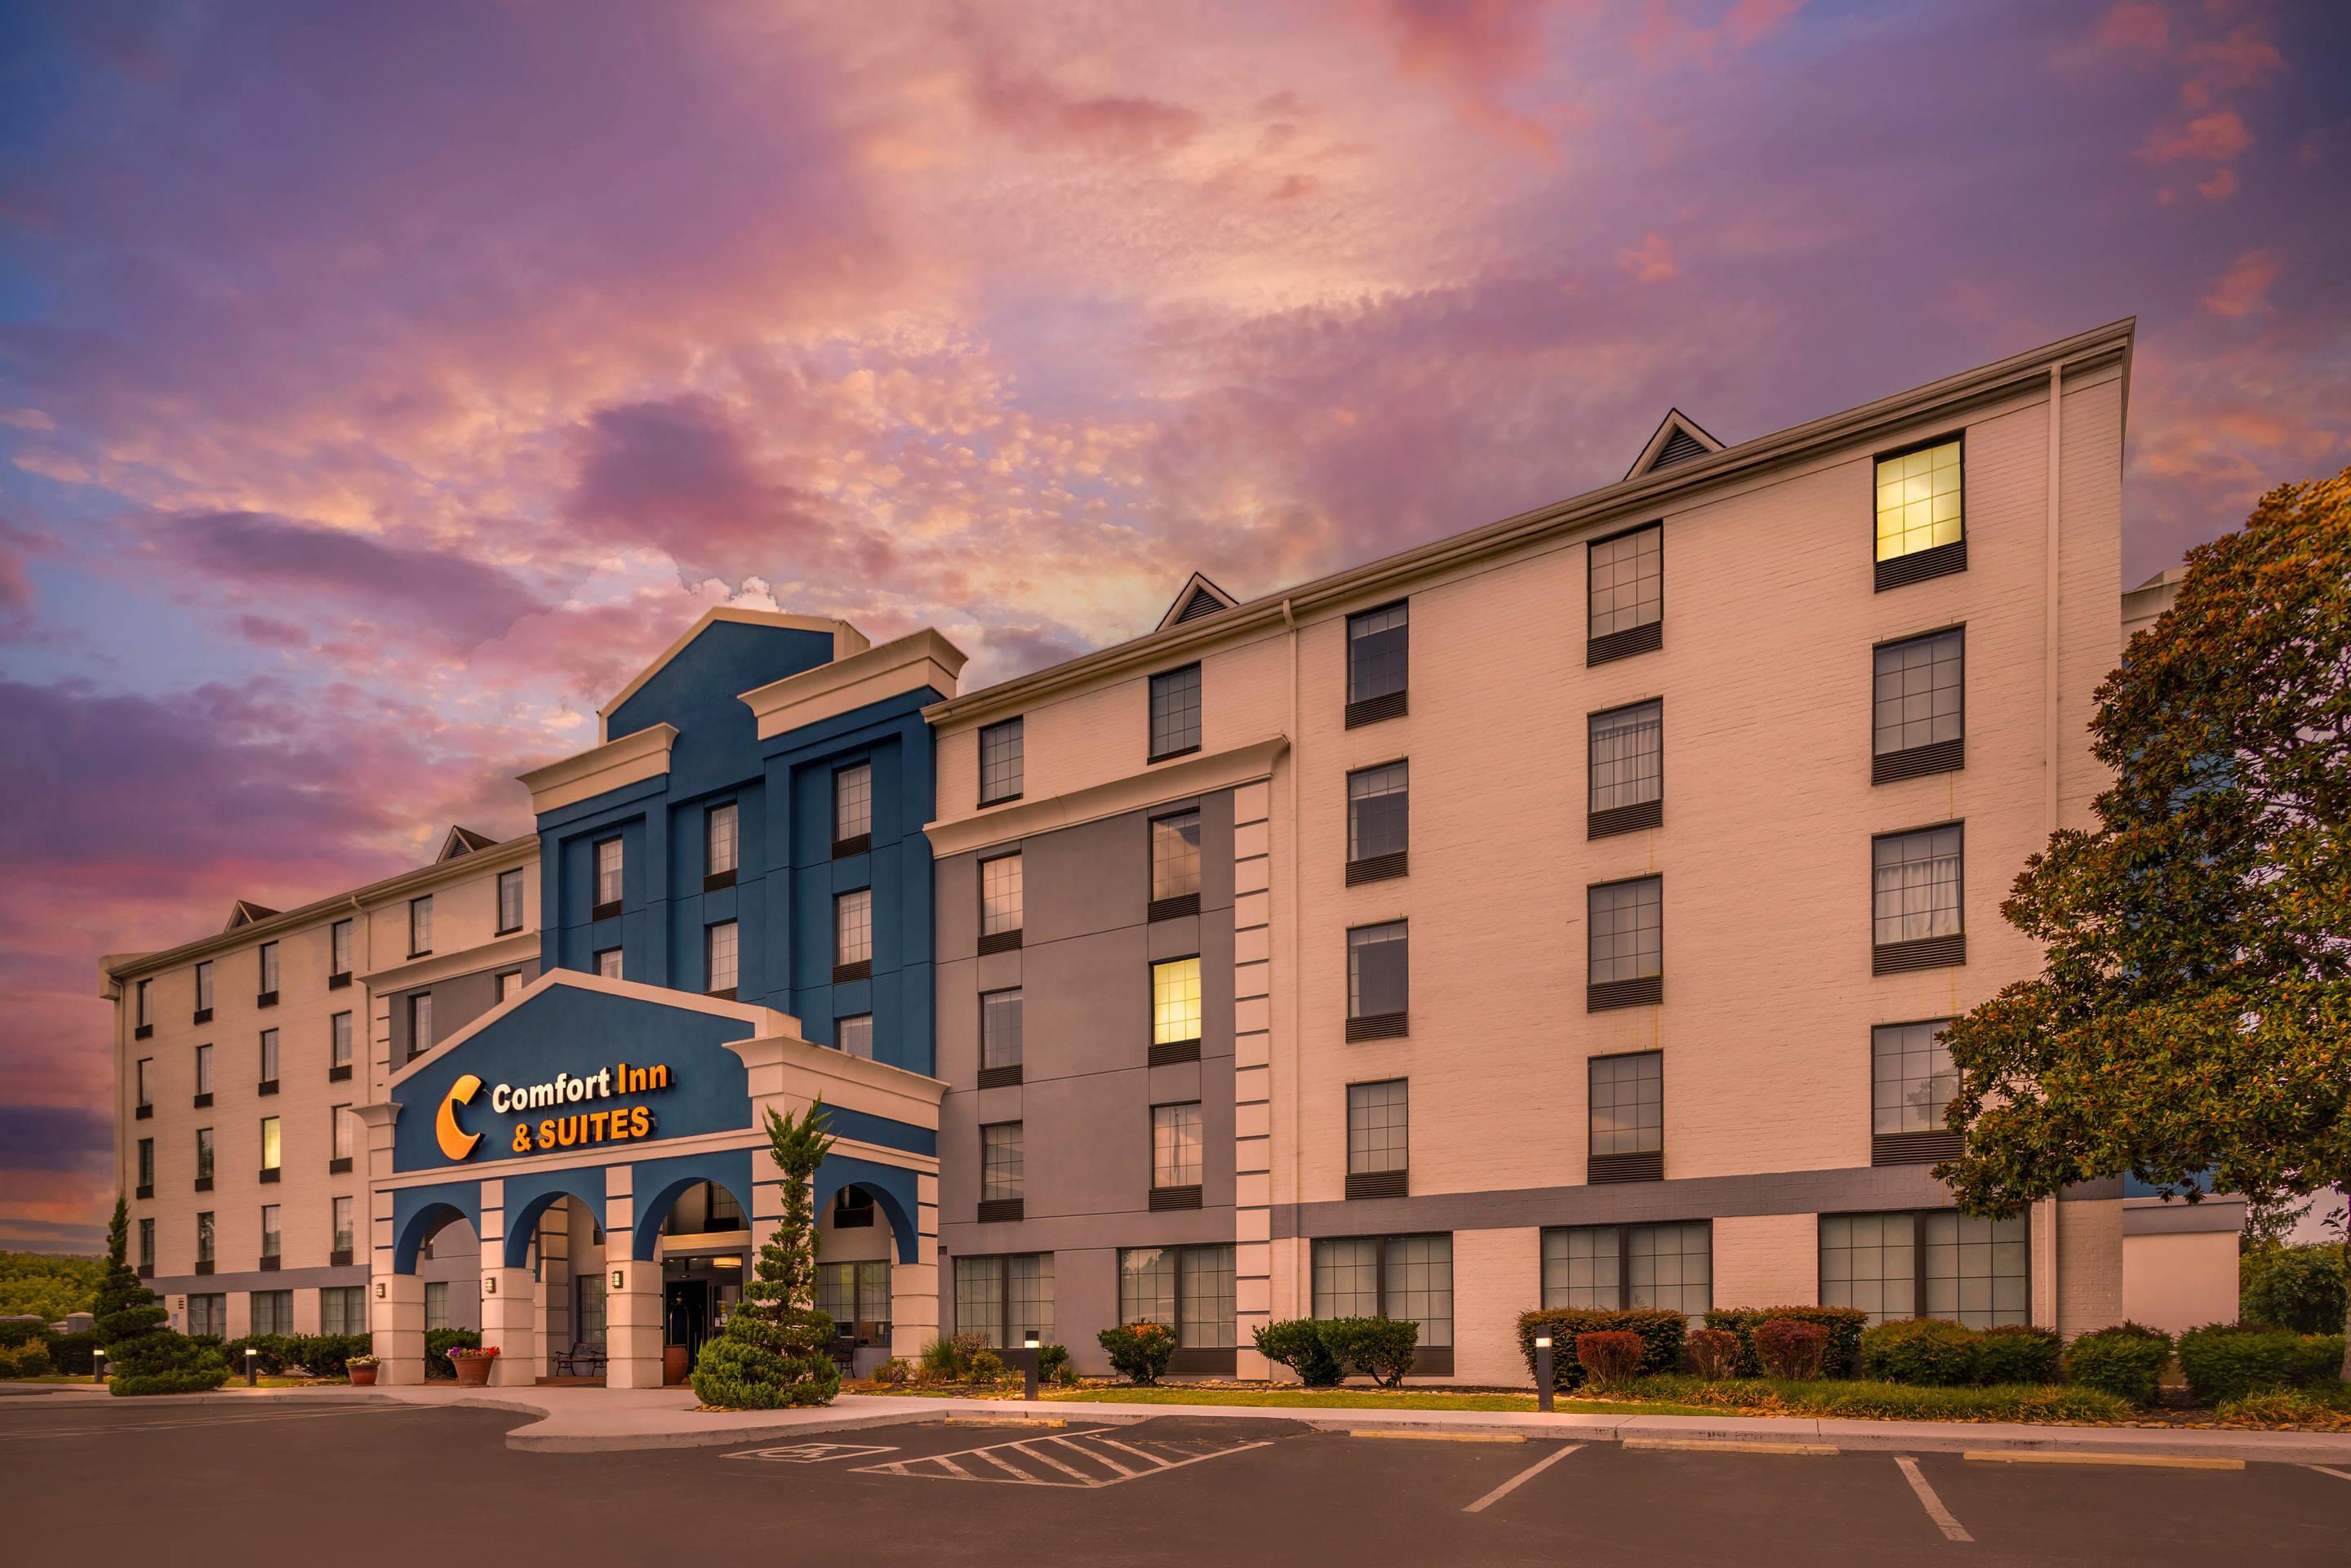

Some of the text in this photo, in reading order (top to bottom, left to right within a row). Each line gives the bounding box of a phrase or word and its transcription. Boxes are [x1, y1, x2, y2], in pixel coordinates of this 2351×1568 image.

[492, 1063, 668, 1113] Comfort Inn
[512, 1106, 650, 1153] & SUITES
